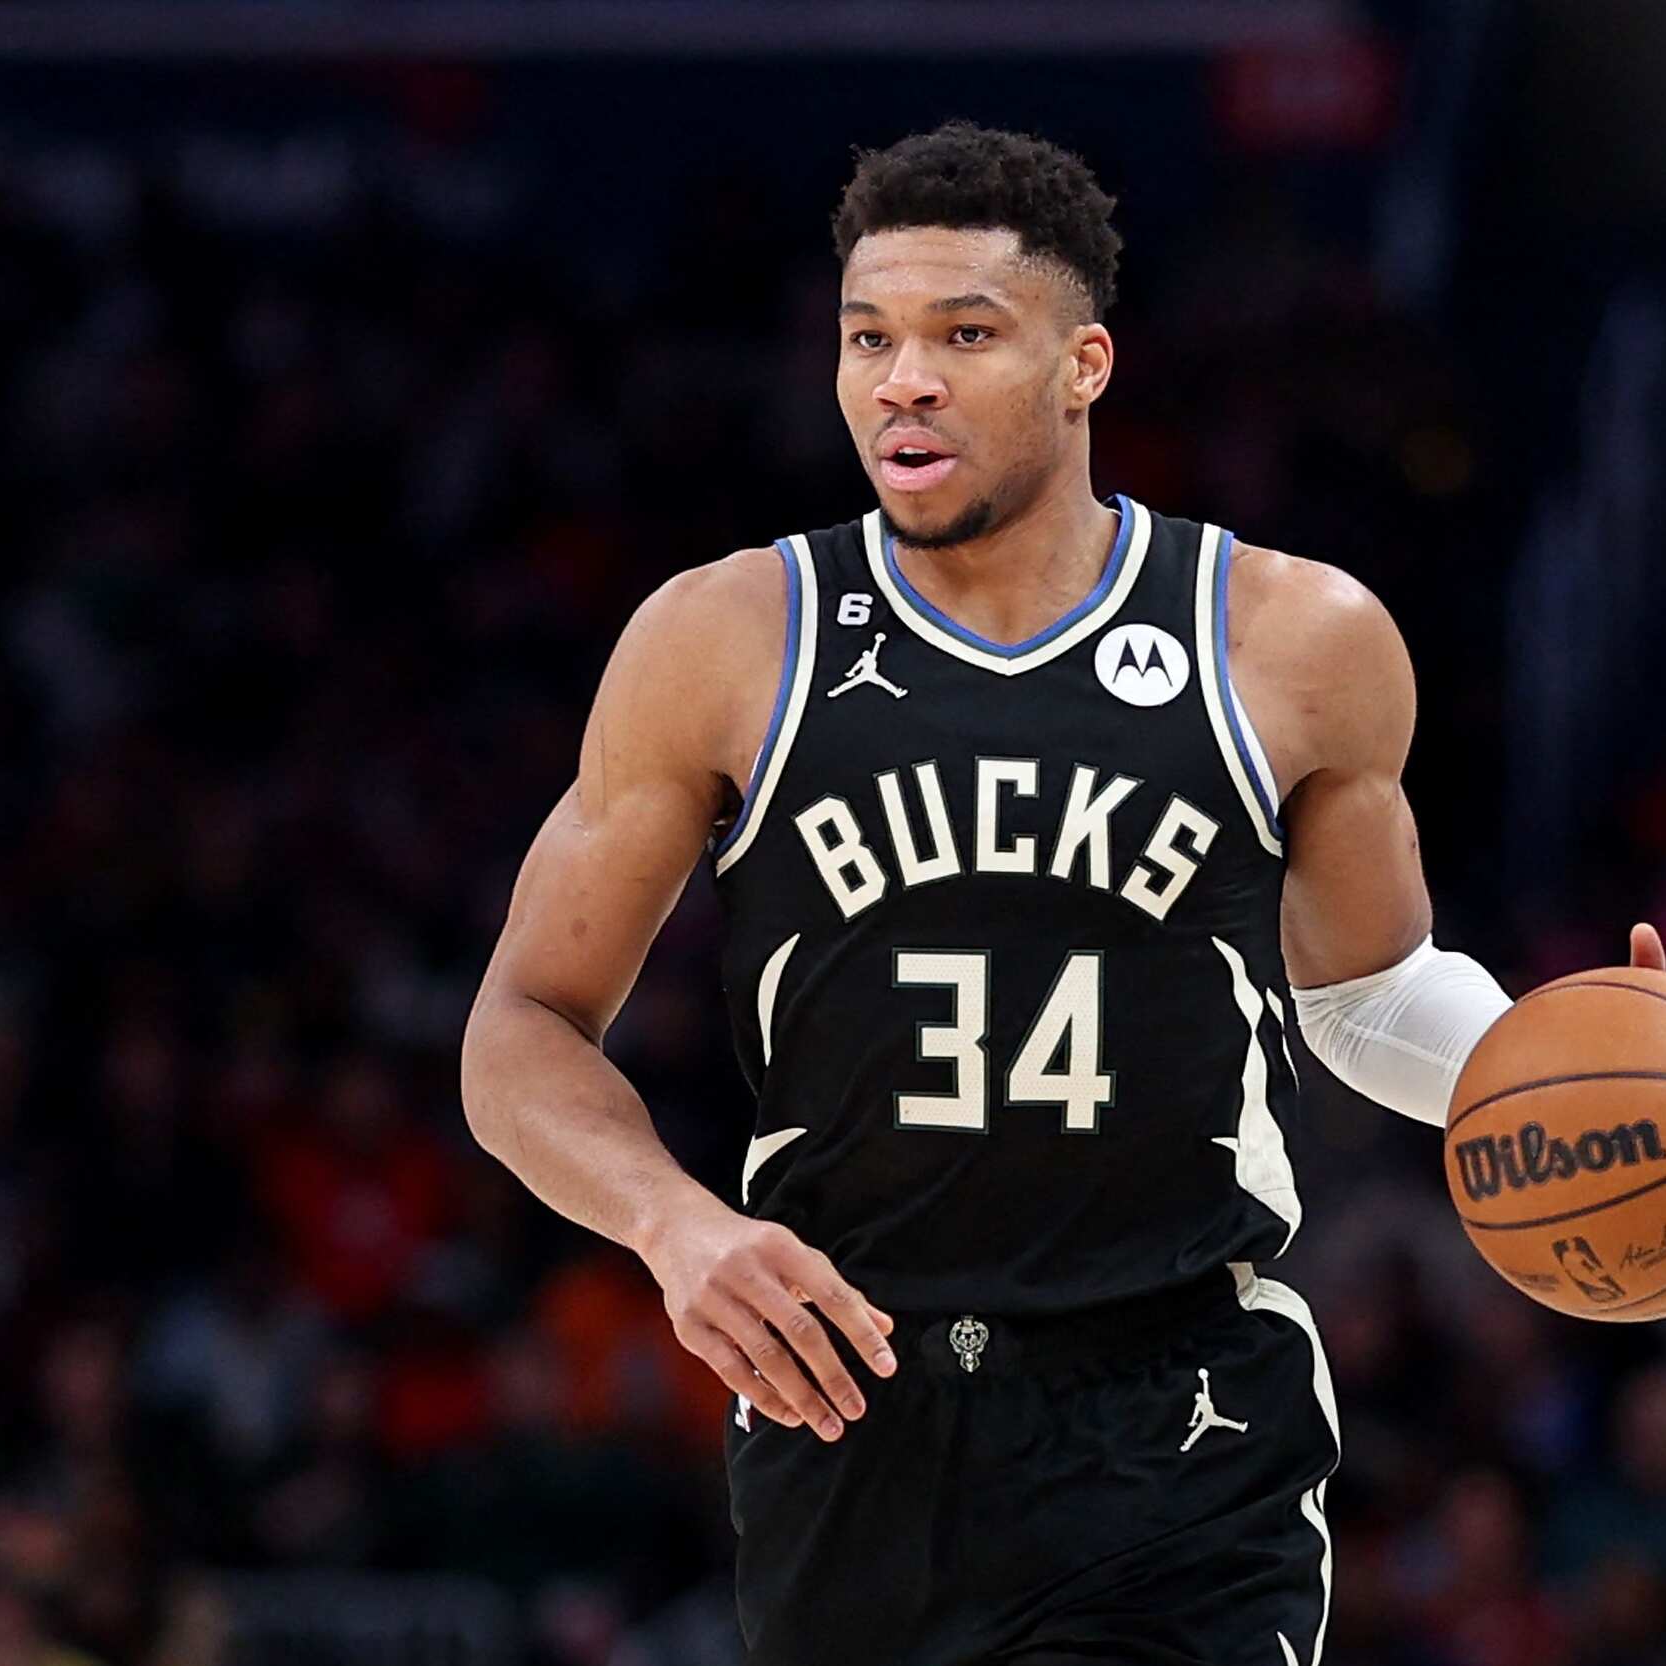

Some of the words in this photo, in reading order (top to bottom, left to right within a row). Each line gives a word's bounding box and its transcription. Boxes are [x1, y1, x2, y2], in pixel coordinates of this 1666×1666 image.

[836, 592, 874, 626] 6
[790, 754, 1223, 924] BUCKS
[891, 946, 1117, 1135] 34
